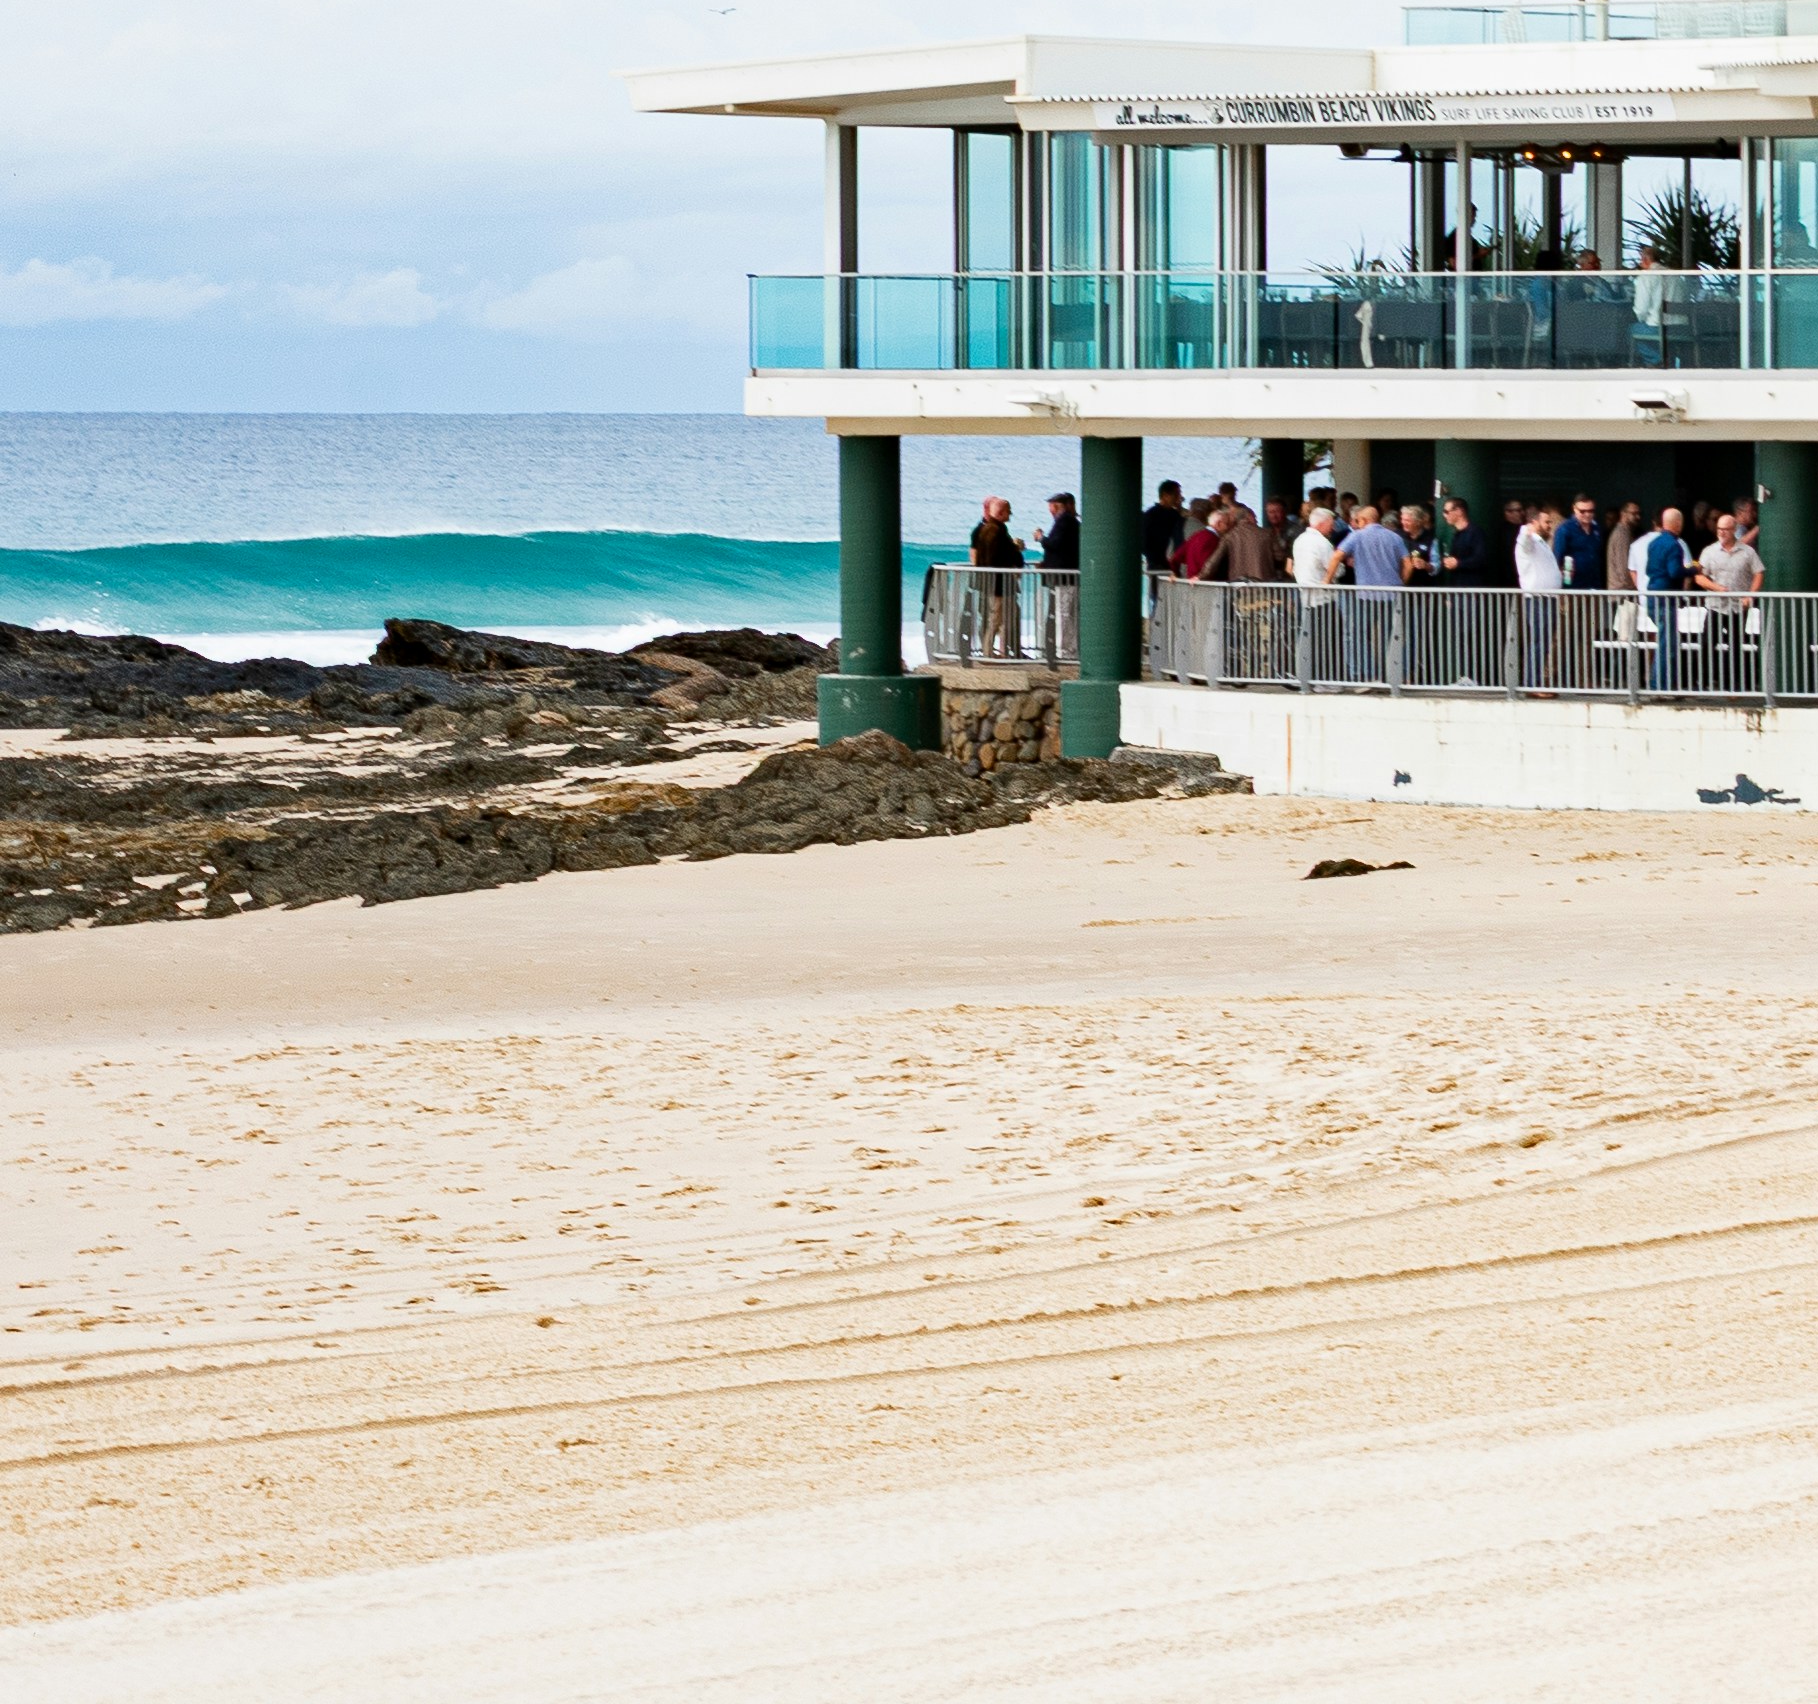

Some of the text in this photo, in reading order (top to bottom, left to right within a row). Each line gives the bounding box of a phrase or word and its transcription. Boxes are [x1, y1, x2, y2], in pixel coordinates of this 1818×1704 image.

[1116, 104, 1135, 124] all
[1226, 98, 1436, 124] CURRUMBIN BEACH VIKINGS
[1441, 105, 1654, 121] SURF LIFE SAVING CLUB EST 1919
